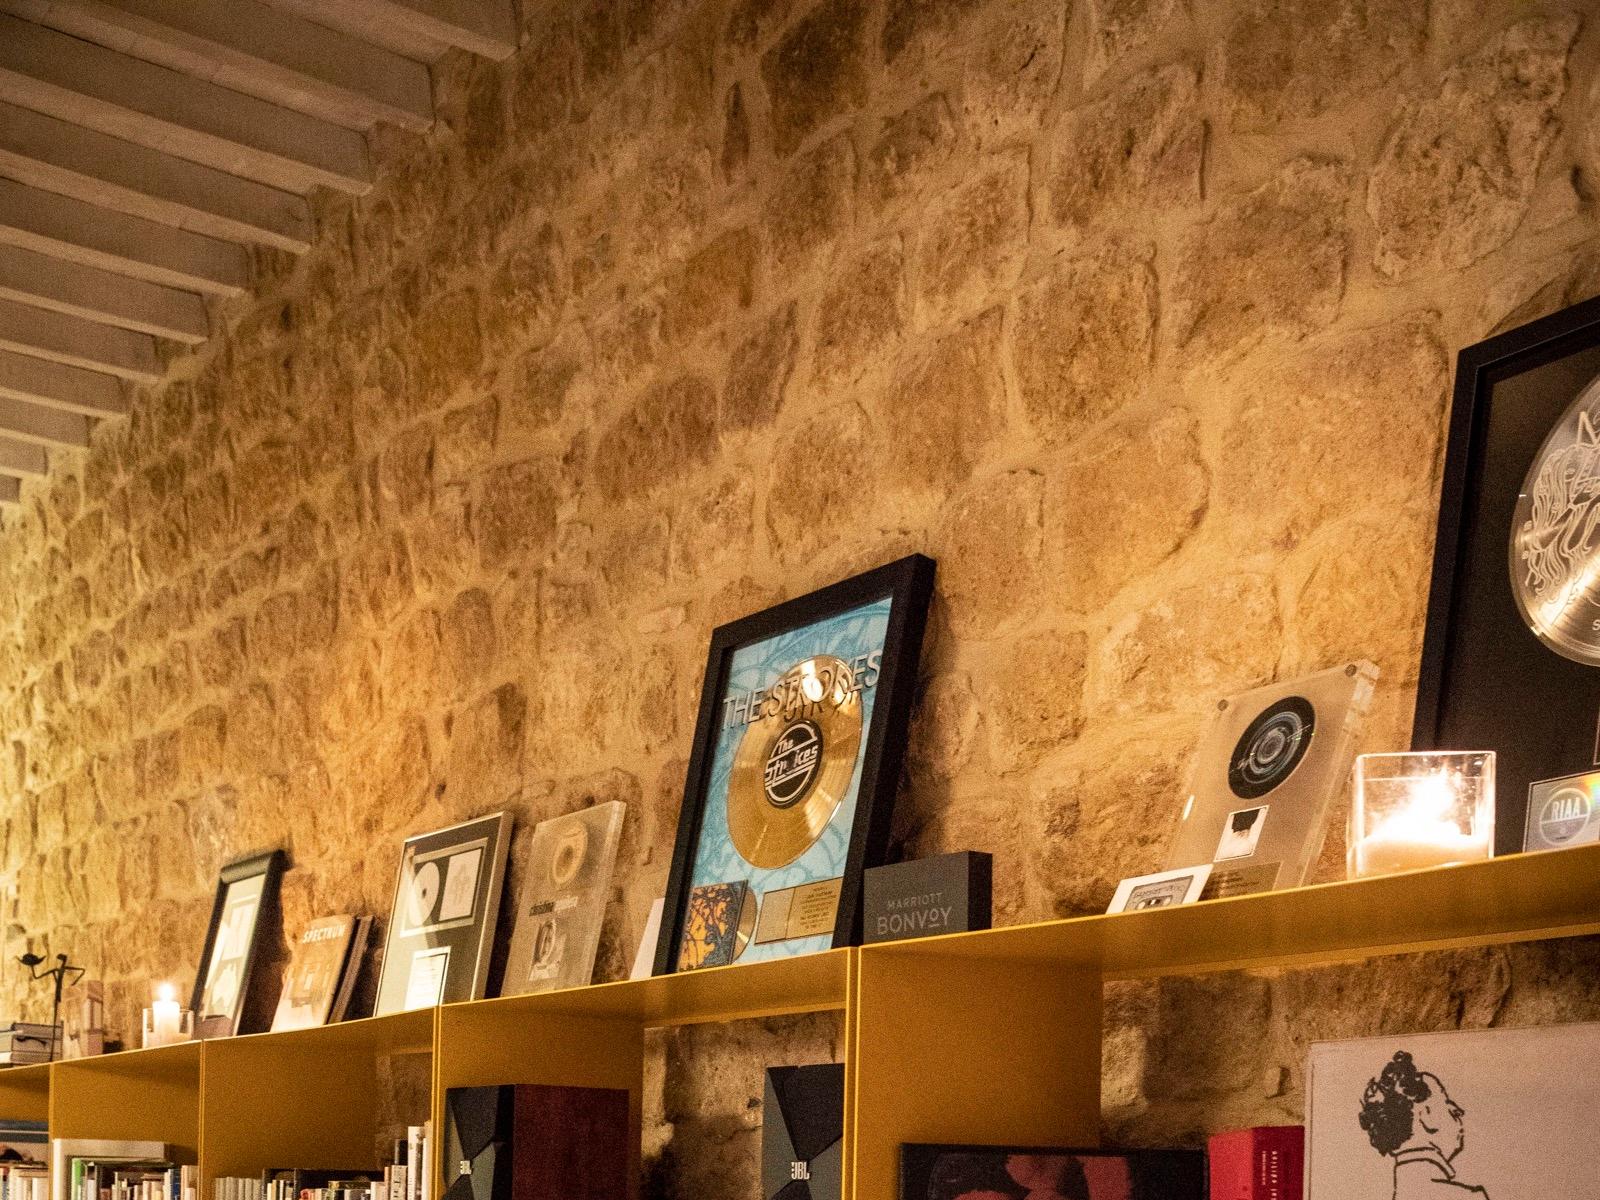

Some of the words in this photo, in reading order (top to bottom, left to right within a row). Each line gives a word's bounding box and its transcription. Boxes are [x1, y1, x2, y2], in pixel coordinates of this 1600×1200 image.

[722, 688, 766, 730] THE
[767, 649, 883, 717] STROKES
[777, 738, 795, 754] The
[765, 745, 819, 783] Strkes
[1551, 797, 1581, 821] RIAA
[886, 892, 944, 910] MARRIOTT
[877, 905, 954, 936] BONVOY
[302, 924, 346, 944] SPECTRUM
[459, 1160, 472, 1175] JBL
[791, 1161, 811, 1180] JBL
